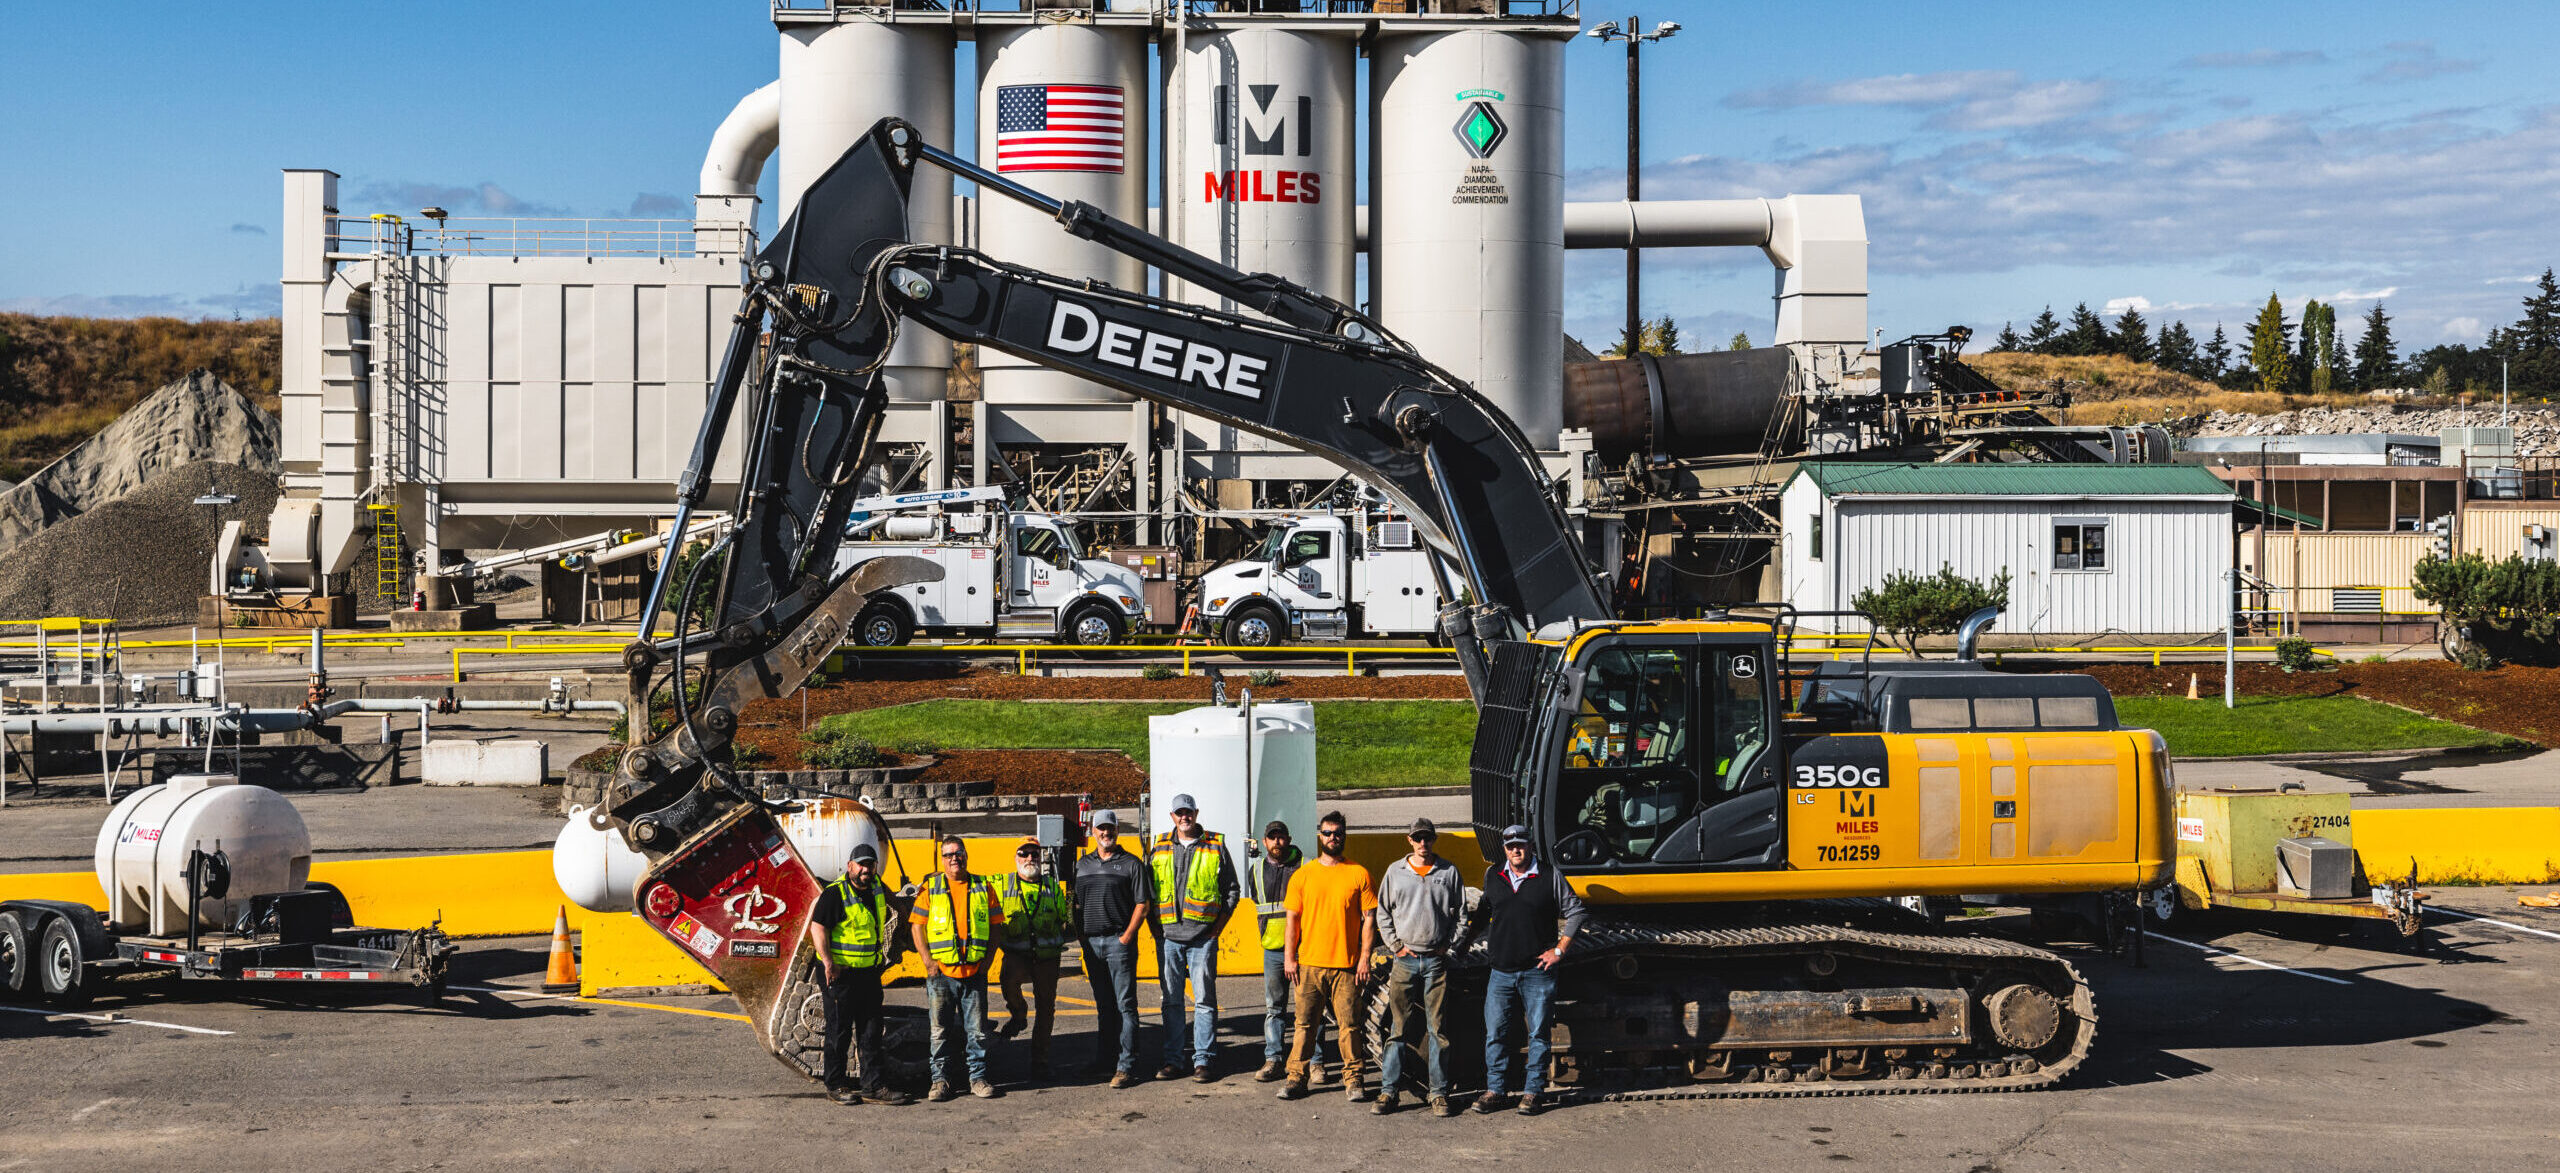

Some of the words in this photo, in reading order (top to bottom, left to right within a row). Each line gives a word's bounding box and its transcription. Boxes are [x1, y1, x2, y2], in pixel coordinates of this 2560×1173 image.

[1461, 89, 1499, 98] SUSTAINABLE
[1471, 165, 1490, 174] NAPA
[1464, 175, 1497, 184] DIAMOND
[1204, 170, 1321, 204] MILES
[1456, 185, 1505, 194] ACHIEVEMENT
[1452, 195, 1509, 205] COMMENDATION
[1047, 299, 1268, 400] DEERE
[1796, 764, 1881, 788] 350G
[1797, 794, 1815, 804] LC
[1836, 821, 1879, 834] MILES
[2312, 815, 2350, 828] 27404
[135, 828, 161, 841] MILES
[2182, 824, 2203, 836] MILES
[1817, 844, 1881, 862] 70.1259
[734, 944, 755, 953] MHP
